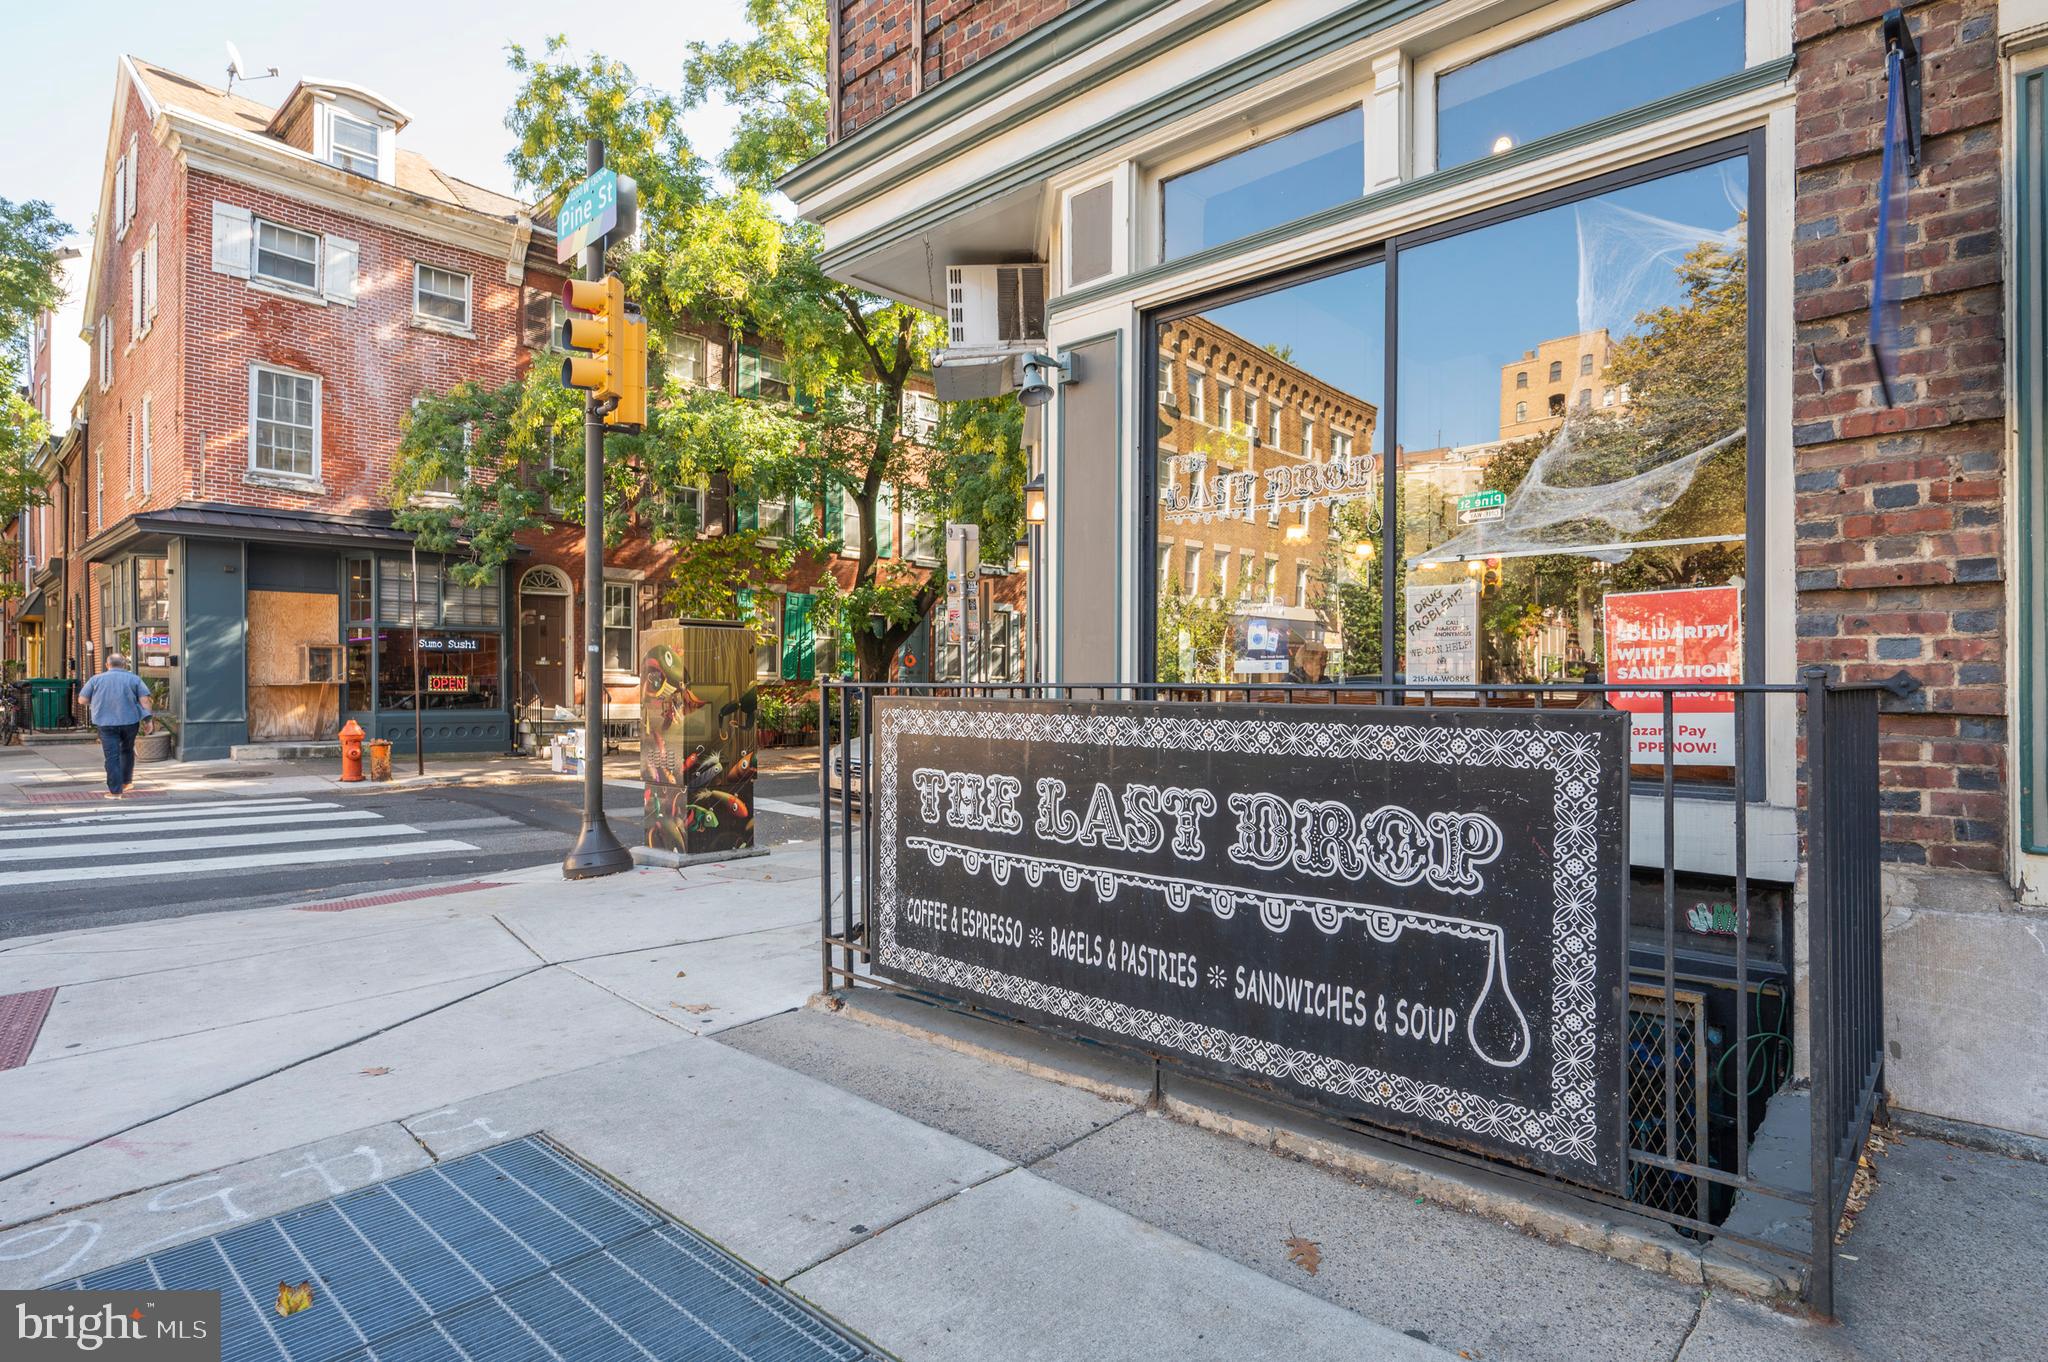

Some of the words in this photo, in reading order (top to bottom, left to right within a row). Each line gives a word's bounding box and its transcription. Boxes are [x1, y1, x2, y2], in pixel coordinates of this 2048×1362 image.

[561, 200, 592, 236] Pine
[598, 181, 613, 209] St
[1166, 452, 1209, 473] THE
[1165, 471, 1258, 512] LAST
[1264, 455, 1376, 500] DROP
[1414, 588, 1443, 614] DRUG
[1408, 588, 1463, 636] PROBLEM?
[1617, 624, 1729, 642] SOLIDARITY
[418, 639, 443, 648] Sumo
[448, 640, 476, 649] Sushi
[1410, 648, 1423, 657] WE
[1425, 644, 1443, 655] CAN
[1445, 640, 1473, 653] HELP!
[1617, 646, 1665, 661] WITH
[1617, 662, 1731, 680] SANITATION
[432, 678, 464, 689] OPEN
[1678, 725, 1707, 739] Pay
[1672, 742, 1717, 754] NOW!
[912, 767, 1023, 835] THE
[1035, 776, 1217, 861] LAST
[1227, 792, 1503, 895] DROP
[931, 844, 1114, 894] COFFEE
[1172, 883, 1393, 933] HOUSE
[907, 898, 948, 932] COFFEE
[951, 907, 959, 934] &
[961, 907, 1023, 948] ESPRESSO
[1050, 926, 1102, 967] BAGELS
[1107, 938, 1116, 969] &
[1121, 940, 1198, 988] PASTRIES
[1235, 965, 1367, 1027] SANDWICHES
[1374, 994, 1387, 1034] &
[1395, 998, 1456, 1046] SOUP
